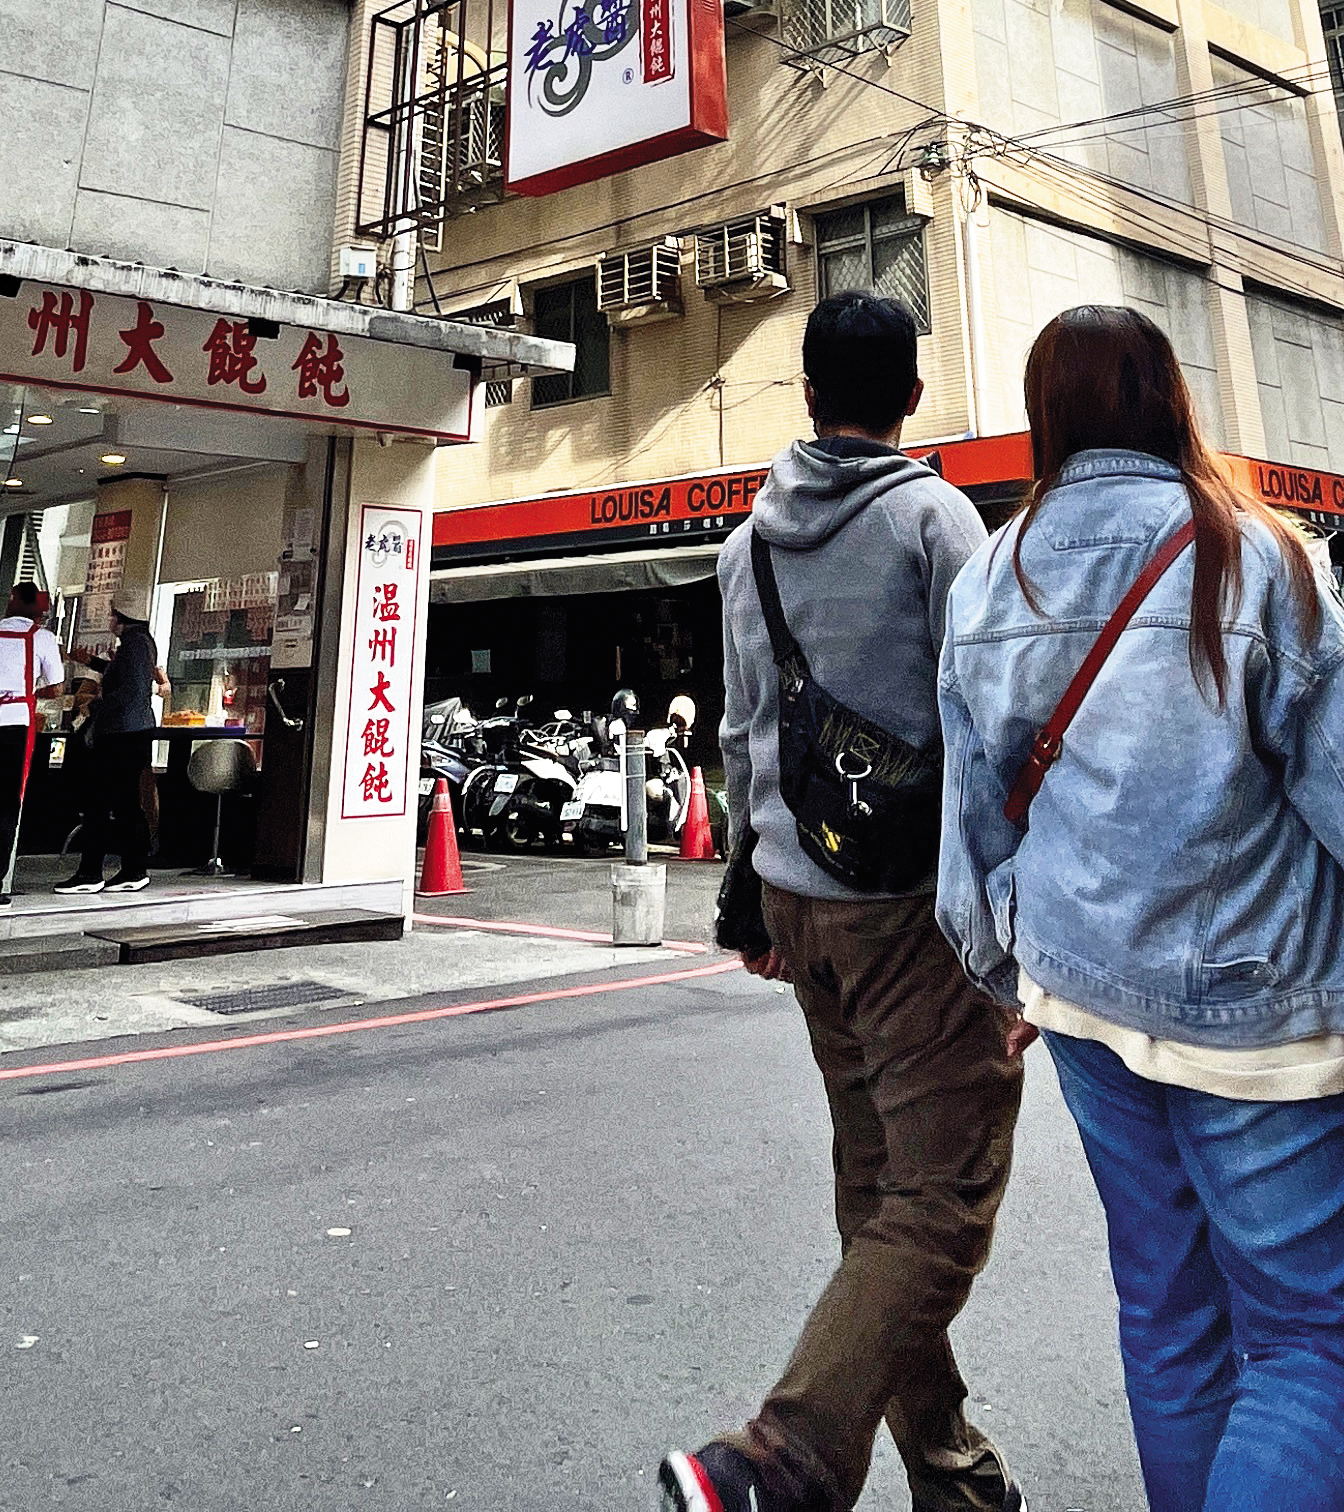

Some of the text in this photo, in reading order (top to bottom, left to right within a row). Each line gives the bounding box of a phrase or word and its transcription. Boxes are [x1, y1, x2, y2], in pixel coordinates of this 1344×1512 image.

[591, 473, 768, 524] LOUISA COFF
[1258, 466, 1324, 506] LOUISA
